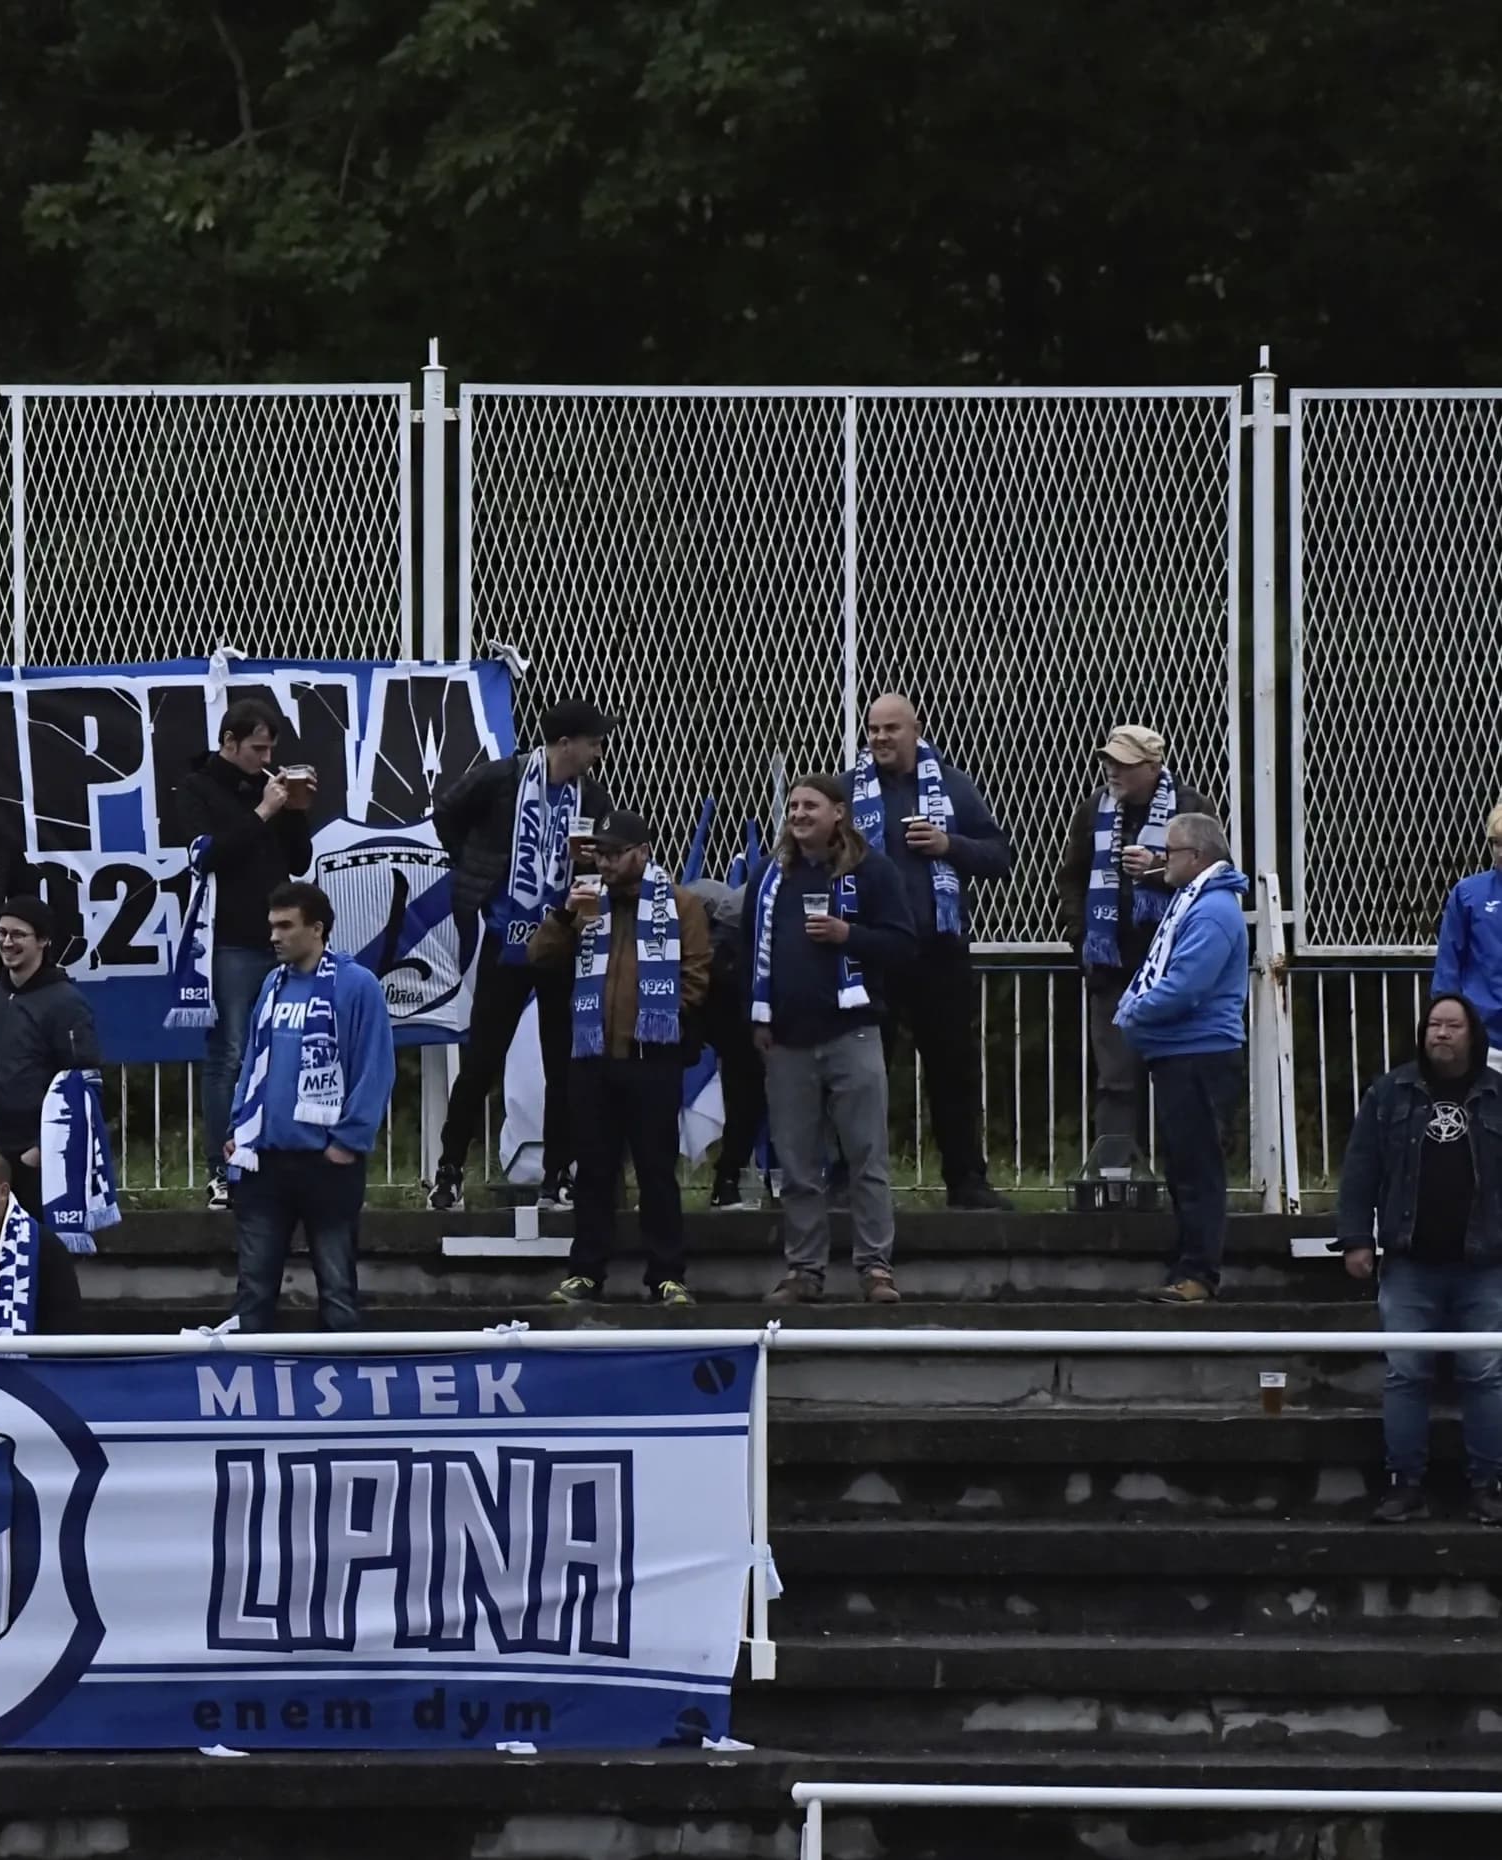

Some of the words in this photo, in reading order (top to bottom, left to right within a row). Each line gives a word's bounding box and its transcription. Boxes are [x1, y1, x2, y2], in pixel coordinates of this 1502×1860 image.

[853, 810, 881, 830] 921
[515, 798, 541, 897] VAMI
[1093, 905, 1119, 921] 192
[507, 920, 539, 945] 192
[180, 987, 209, 1001] 1921
[639, 978, 675, 995] 1921
[272, 1002, 307, 1030] IPIN
[302, 1070, 338, 1092] MFK
[53, 1210, 84, 1224] 1921
[196, 1359, 527, 1418] MÍSTEK
[206, 1446, 634, 1659] LIPINA
[192, 1699, 372, 1732] enem
[413, 1687, 554, 1739] dym
